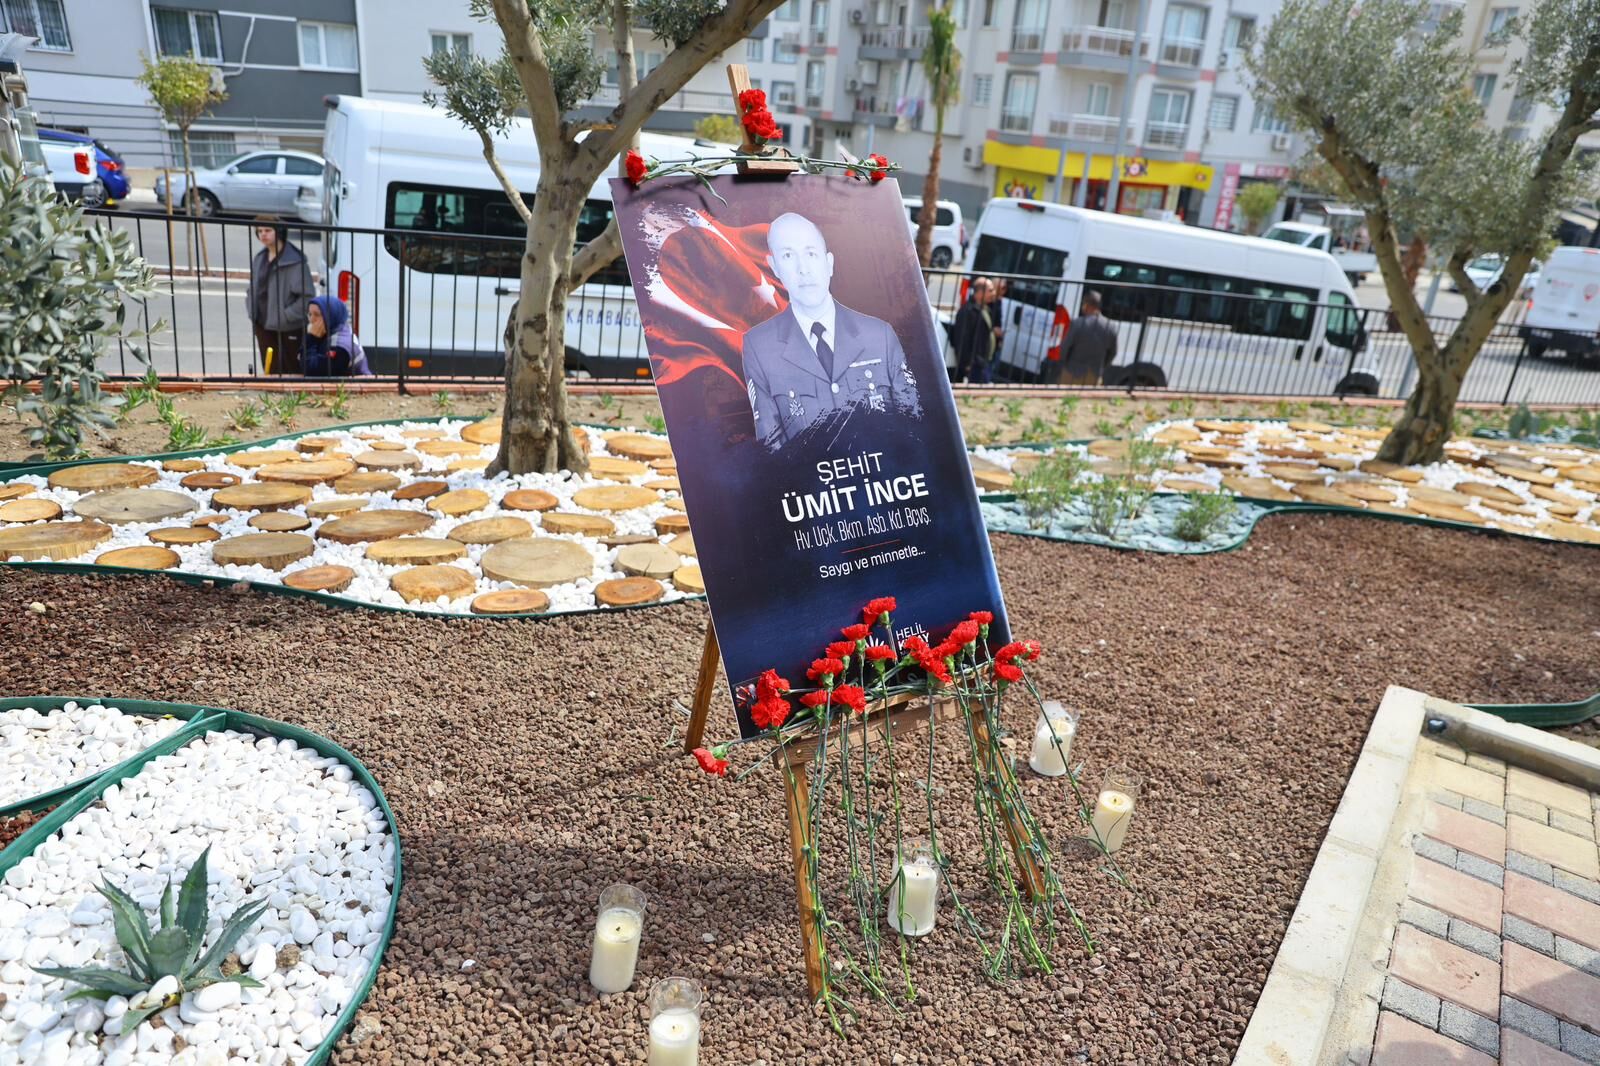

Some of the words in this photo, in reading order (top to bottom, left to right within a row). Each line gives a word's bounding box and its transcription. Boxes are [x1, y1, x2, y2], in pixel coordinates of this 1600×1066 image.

[816, 451, 883, 485] ŞEHİT
[781, 484, 857, 522] ÜMİT
[863, 473, 929, 506] İNCE
[794, 529, 814, 551] Hv.
[812, 522, 839, 548] Uçk.
[837, 519, 867, 541] Bkm.
[866, 512, 890, 535] Asb.
[887, 507, 906, 530] Kd.
[904, 506, 932, 528] Bçvş.
[819, 561, 854, 578] Saygı
[854, 557, 869, 570] ve
[870, 545, 926, 567] minnetle...
[895, 622, 926, 640] HELİL
